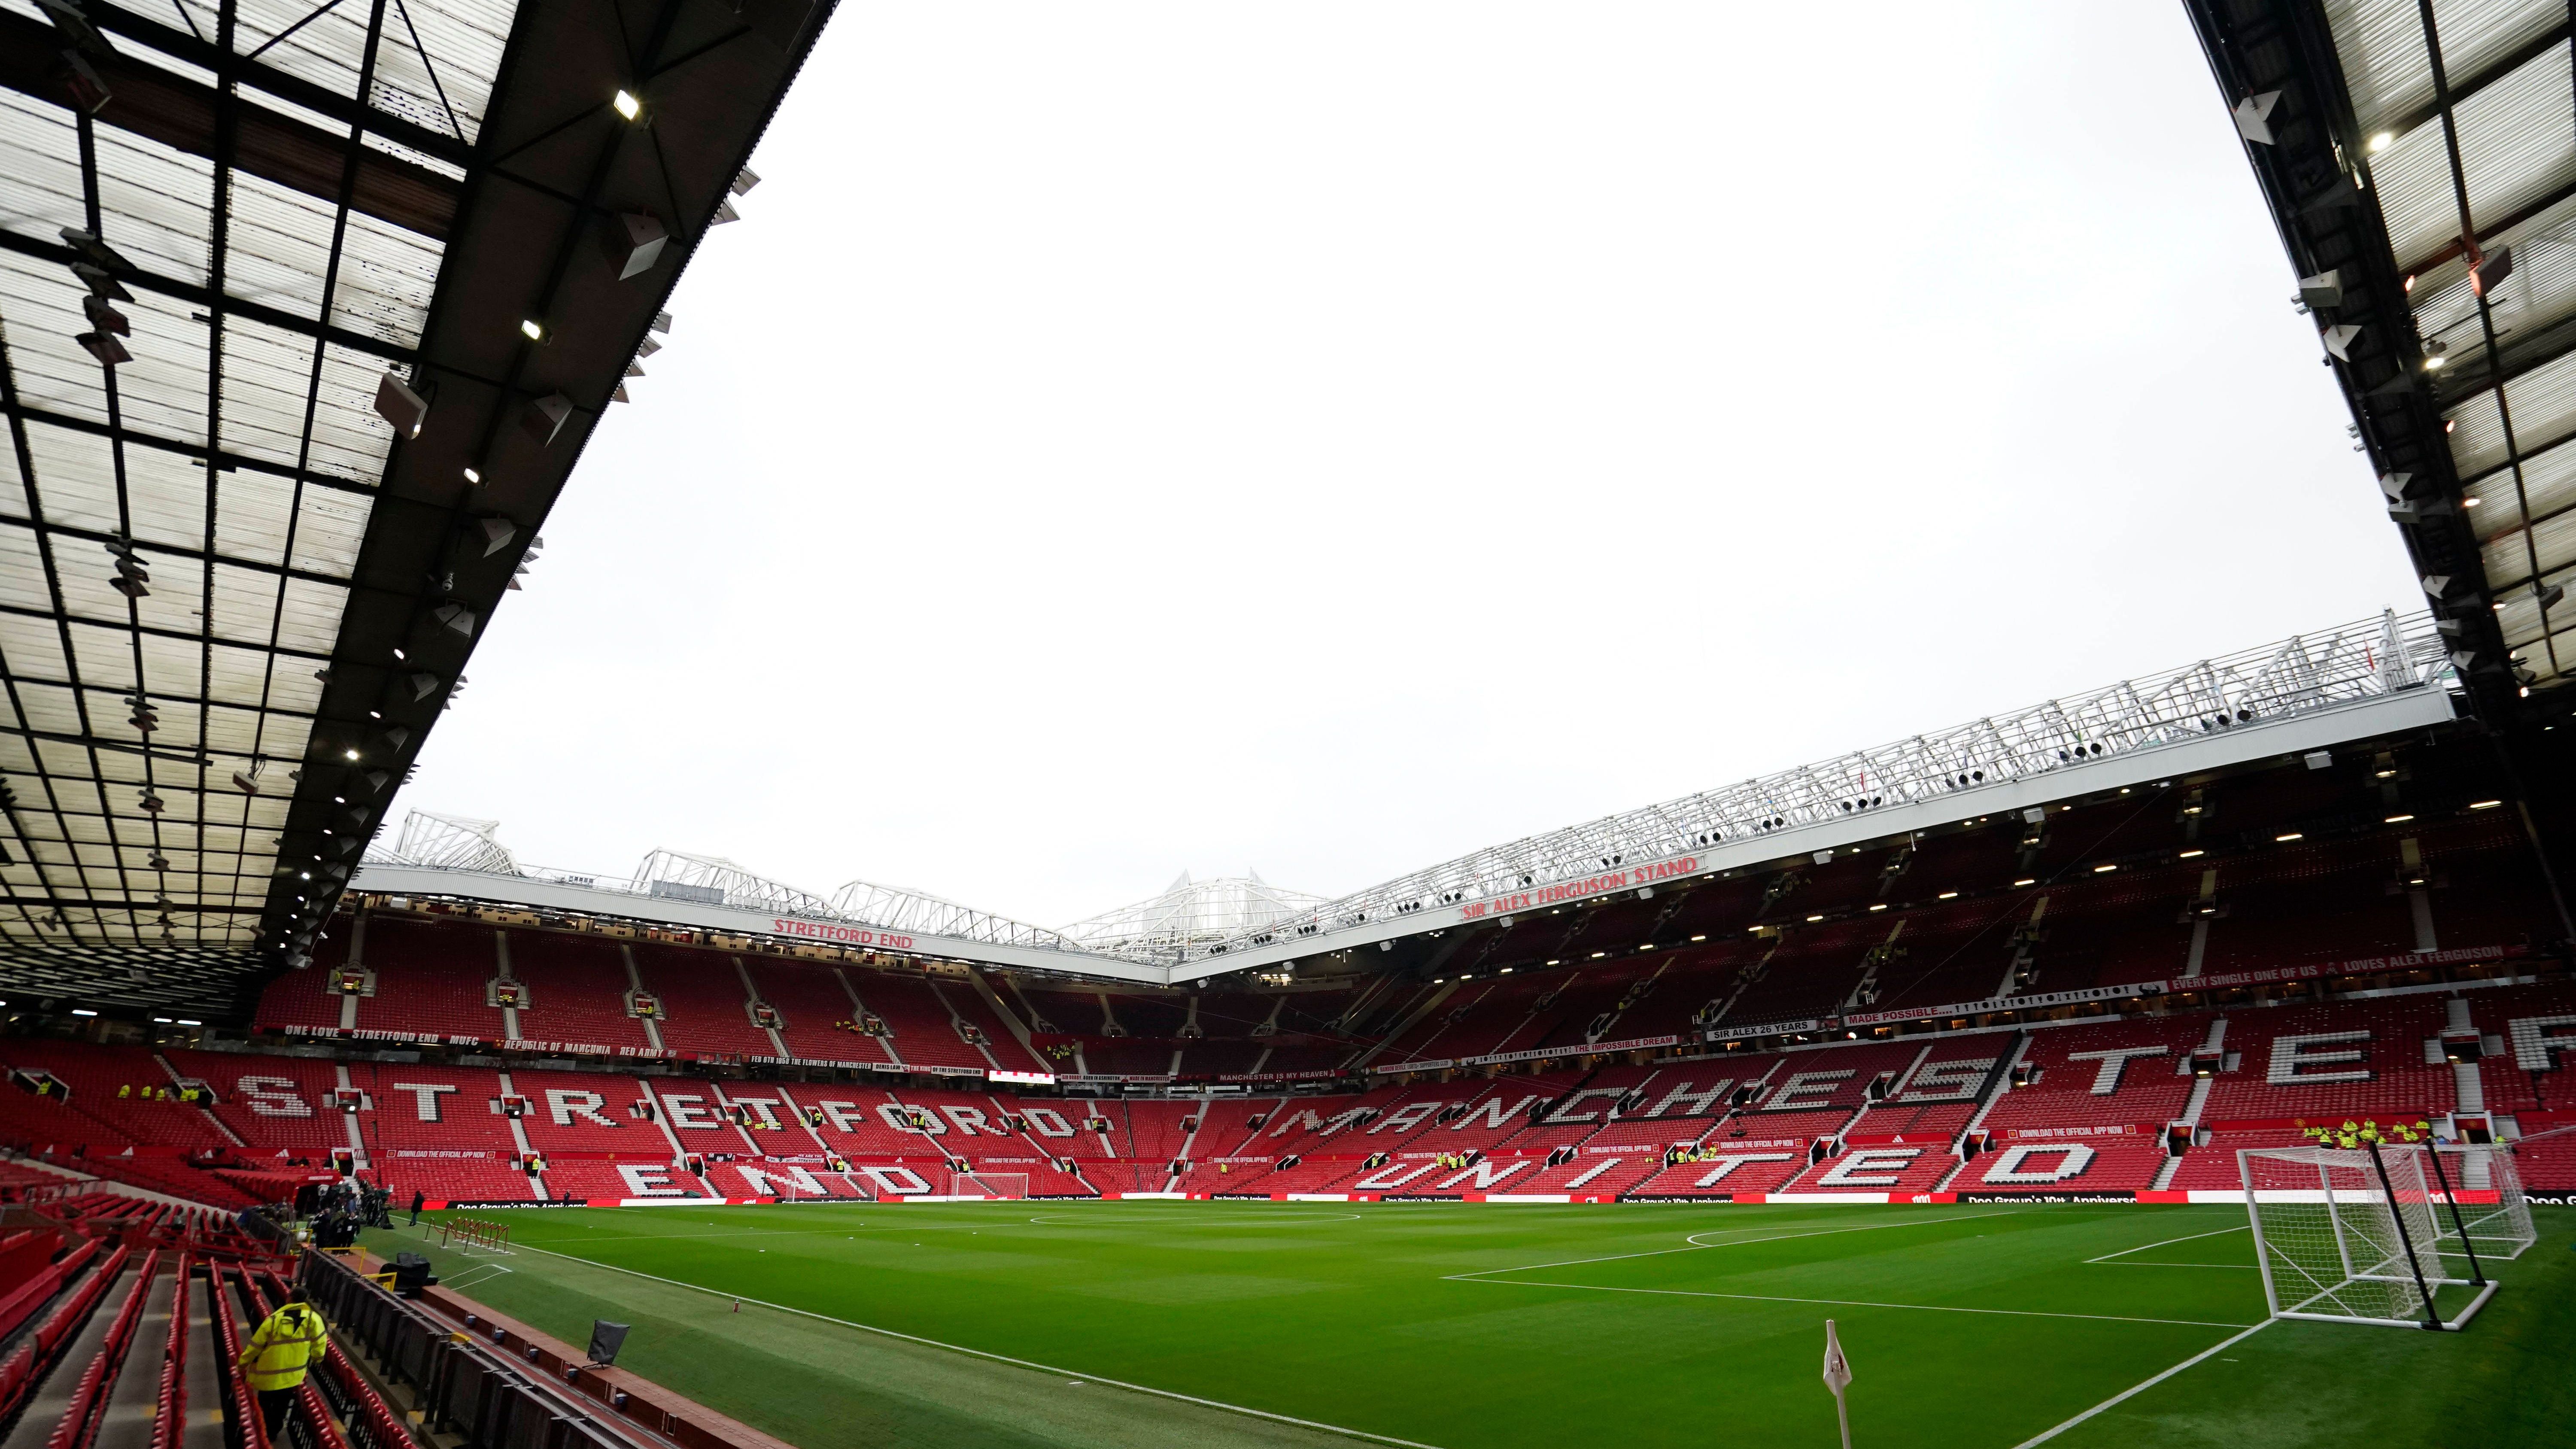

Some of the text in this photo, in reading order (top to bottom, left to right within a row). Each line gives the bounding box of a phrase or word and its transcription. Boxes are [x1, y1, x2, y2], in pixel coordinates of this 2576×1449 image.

[1463, 857, 1697, 920] SIR ALEX FERGUSON STAND
[775, 919, 912, 948] STRETFORD END
[2172, 945, 2504, 989] EVERY SINGLE ONE OF US LOVES ALEX FERGUSON
[1849, 1015, 1879, 1024] MADE
[285, 1025, 340, 1037] ONE LOVE
[1732, 1027, 1757, 1036] ALEX
[1774, 1022, 1808, 1032] YEARS
[352, 1029, 479, 1046] STRETFORD END MUFC
[1592, 1039, 1640, 1051] IMPOSSIBLE
[1643, 1036, 1673, 1046] DREAM
[550, 1042, 561, 1051] OF
[802, 1059, 828, 1067] FLOWERS
[837, 1061, 872, 1069] MANCHESTER
[2019, 1126, 2123, 1138] DOWNLOAD THE OFFICIAL APP NOW
[617, 1164, 932, 1197] END
